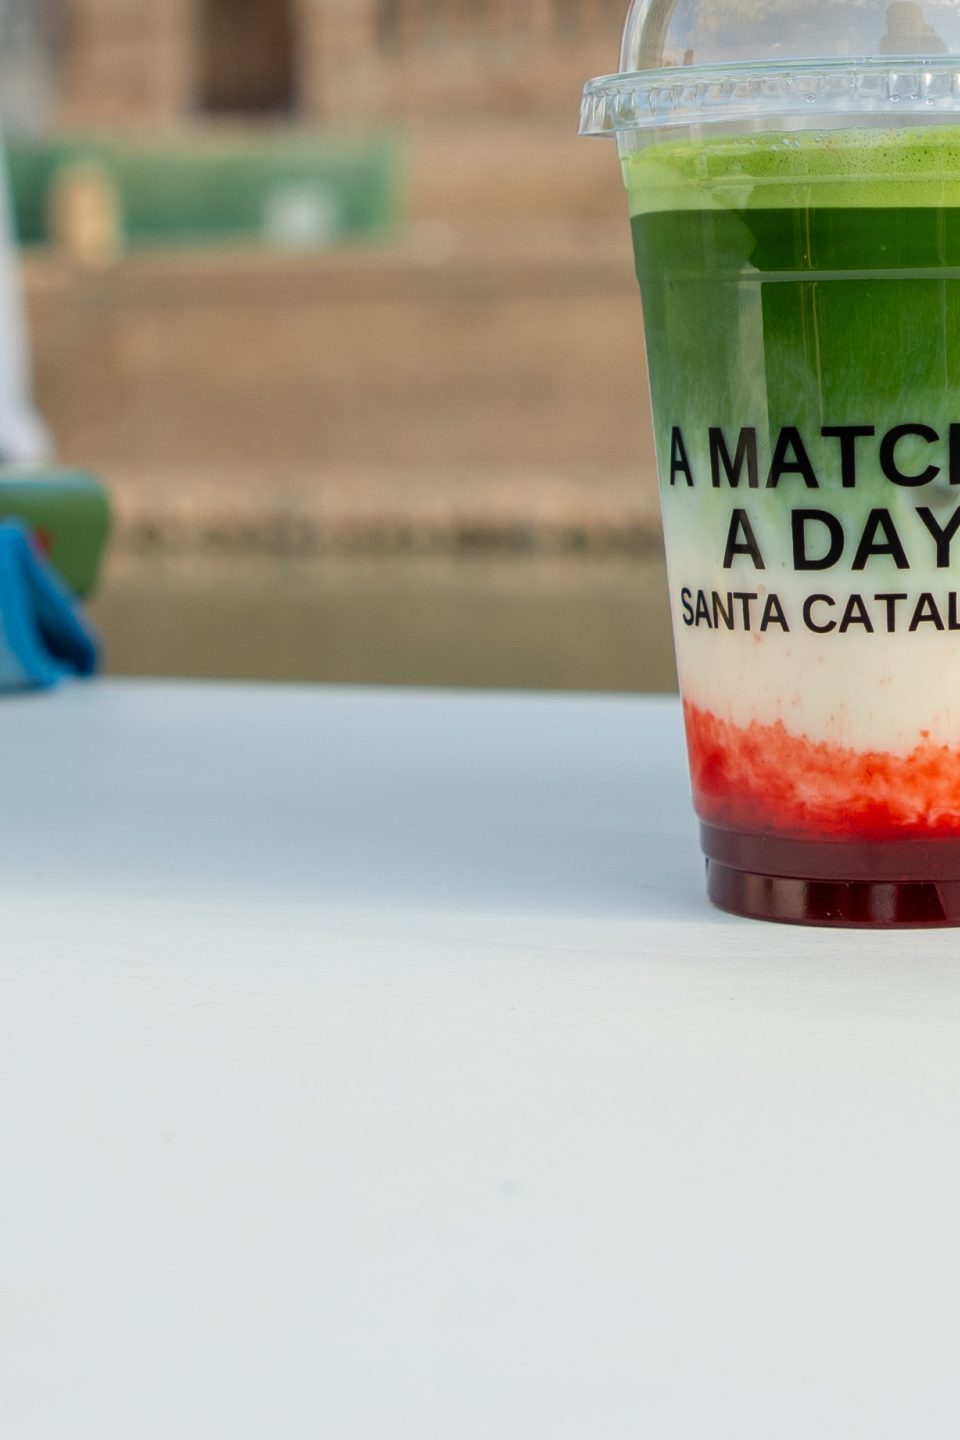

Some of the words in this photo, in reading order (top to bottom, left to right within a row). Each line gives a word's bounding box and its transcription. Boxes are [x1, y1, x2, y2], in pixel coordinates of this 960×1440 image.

[670, 426, 694, 487] A
[723, 508, 766, 570] A
[681, 587, 790, 633] SANTA
